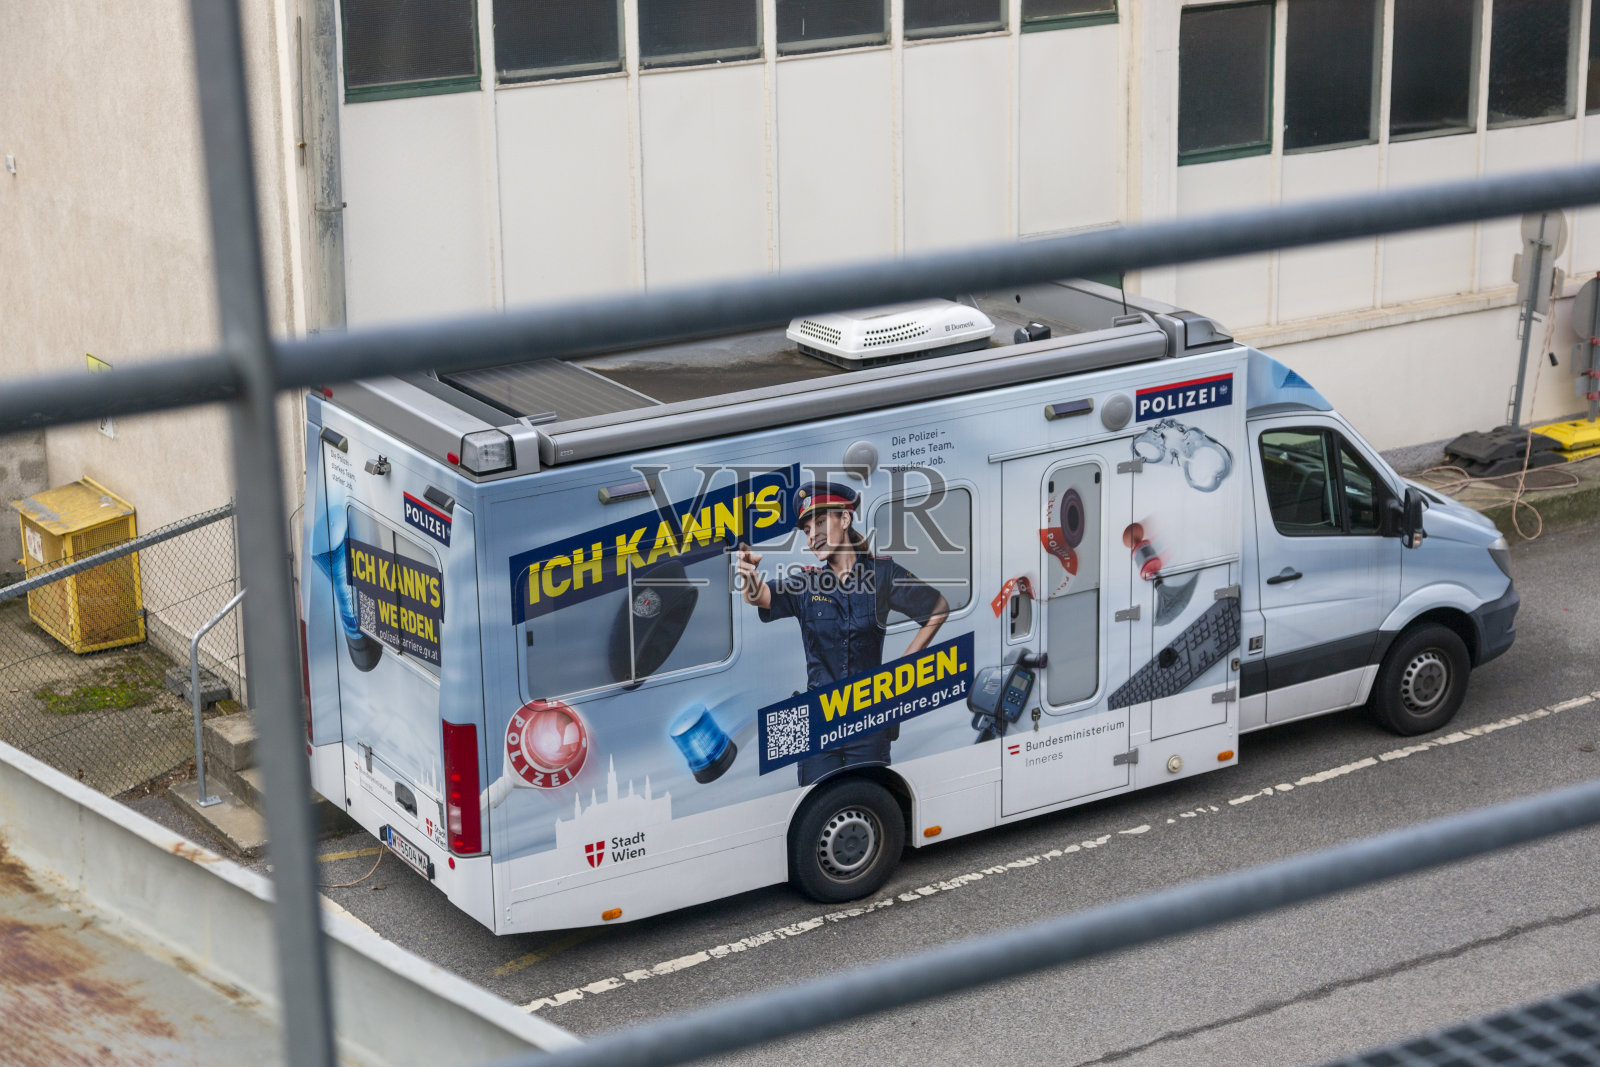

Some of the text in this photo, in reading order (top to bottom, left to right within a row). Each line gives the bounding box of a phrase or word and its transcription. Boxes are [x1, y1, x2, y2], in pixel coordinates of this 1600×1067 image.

[951, 320, 975, 331] Dometic
[1139, 386, 1216, 416] POLIZEI
[891, 436, 906, 447] Die
[908, 428, 938, 443] Polizei
[892, 441, 955, 460] starkes Team,
[892, 455, 946, 474] starker Job.
[406, 502, 446, 540] POLIZEI
[528, 484, 782, 606] ICH KANN'S
[351, 547, 440, 608] ICH KANN'S
[377, 599, 438, 643] WERDEN.
[819, 645, 968, 722] WERDEN.
[820, 679, 967, 749] polizeikarriere.gv.at
[507, 713, 574, 787] POLIZEI
[1025, 720, 1125, 752] Bundesministerium
[1025, 752, 1064, 767] Inneres
[434, 824, 446, 839] Stad
[611, 832, 646, 849] Stadt
[611, 847, 646, 862] Wien
